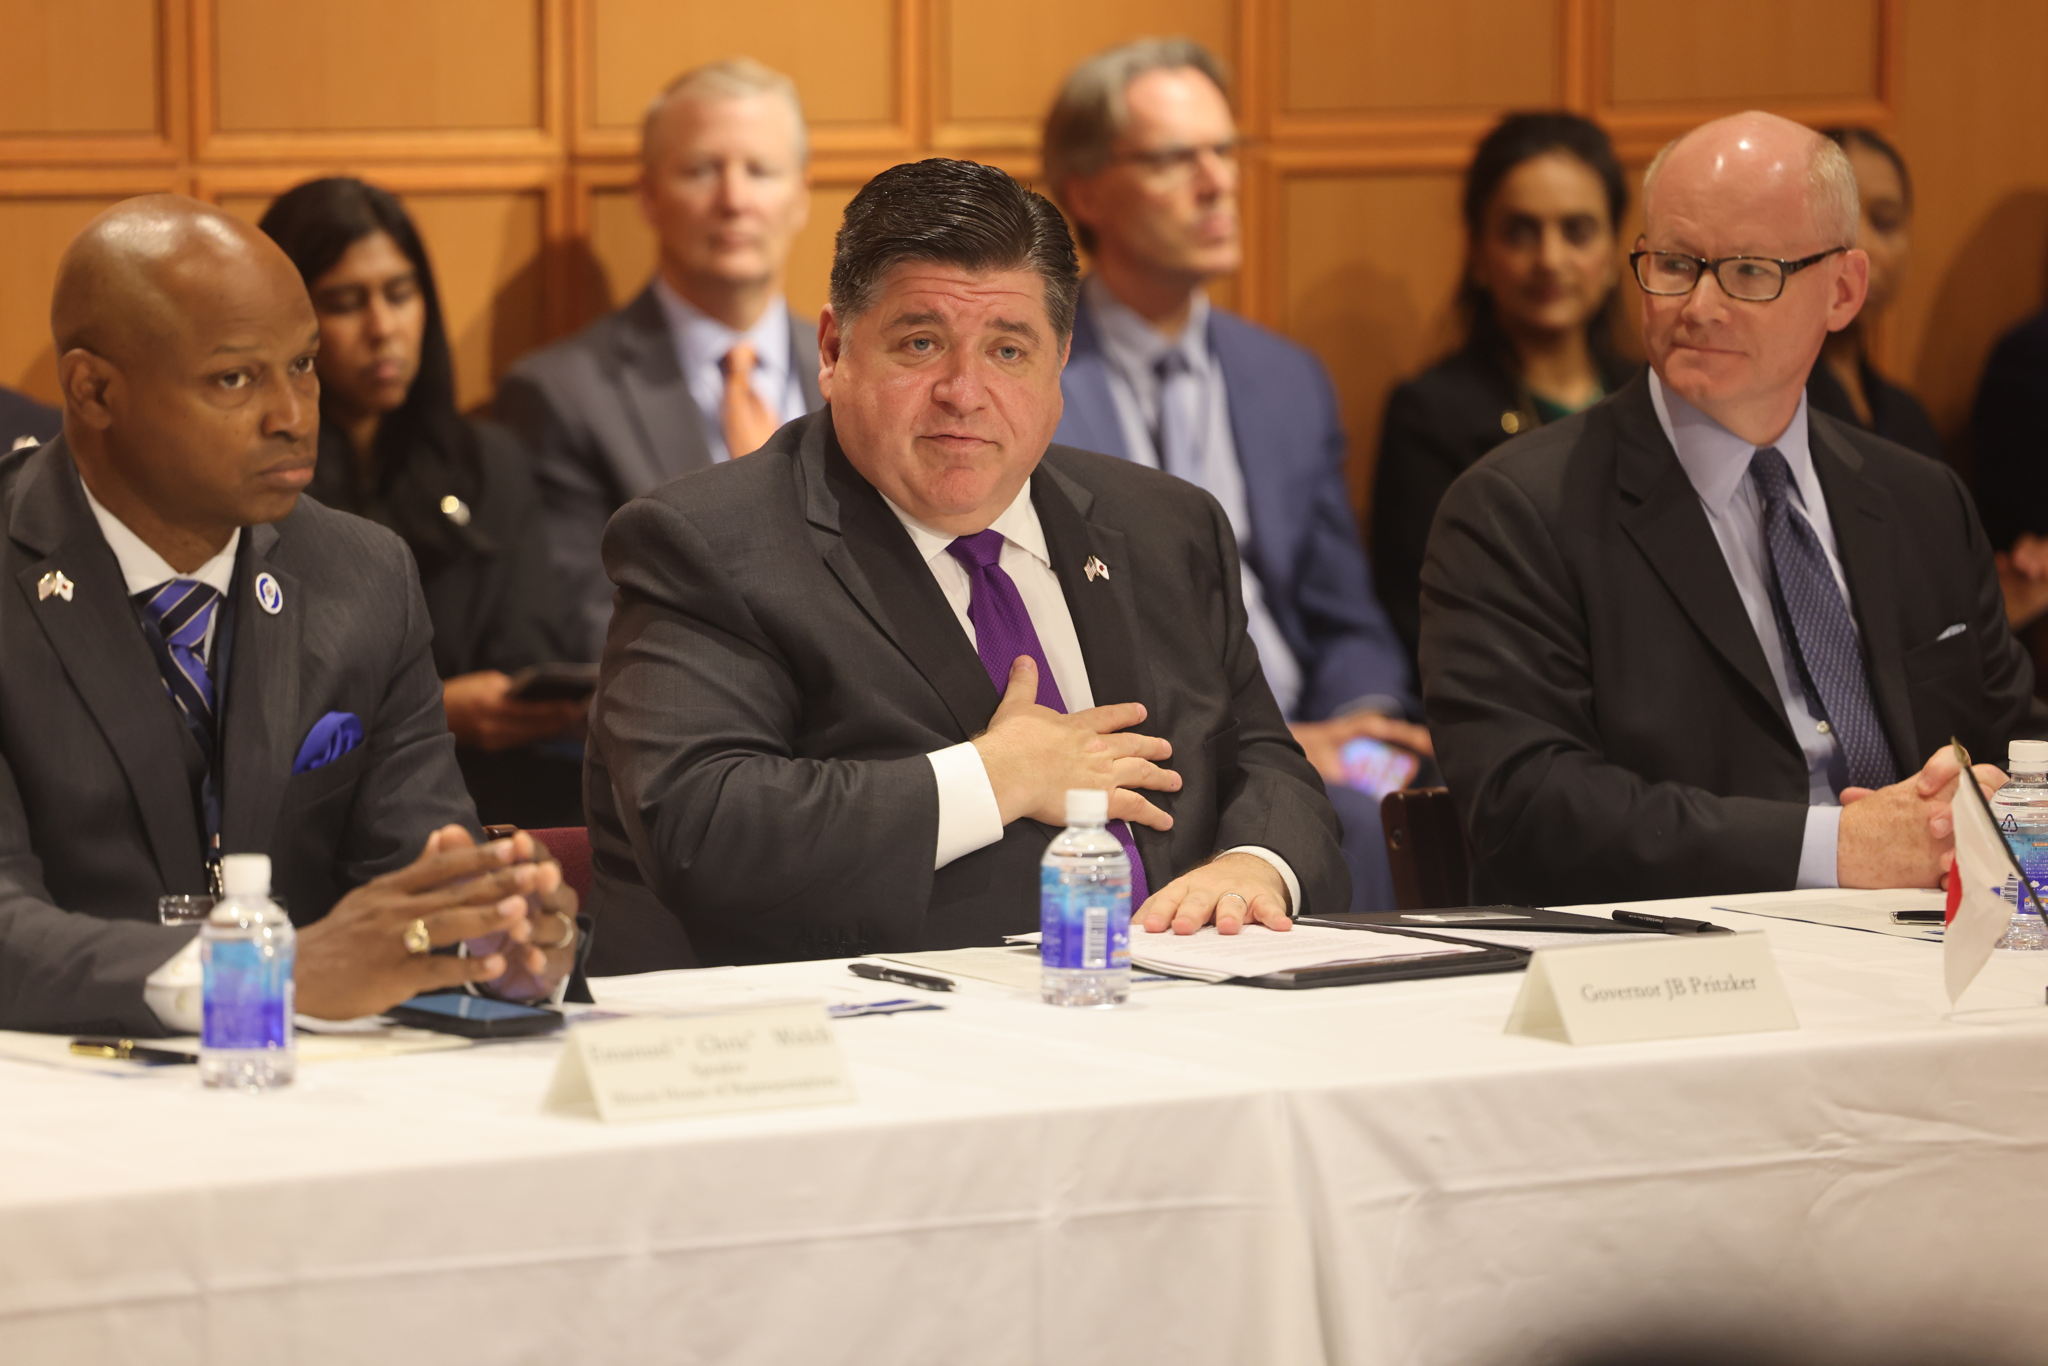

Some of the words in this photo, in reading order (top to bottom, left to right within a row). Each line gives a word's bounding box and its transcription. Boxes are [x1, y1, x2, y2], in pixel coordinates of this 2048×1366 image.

[1581, 983, 1661, 1002] Governor
[1664, 976, 1687, 1001] JB
[1689, 973, 1757, 996] Pritzker
